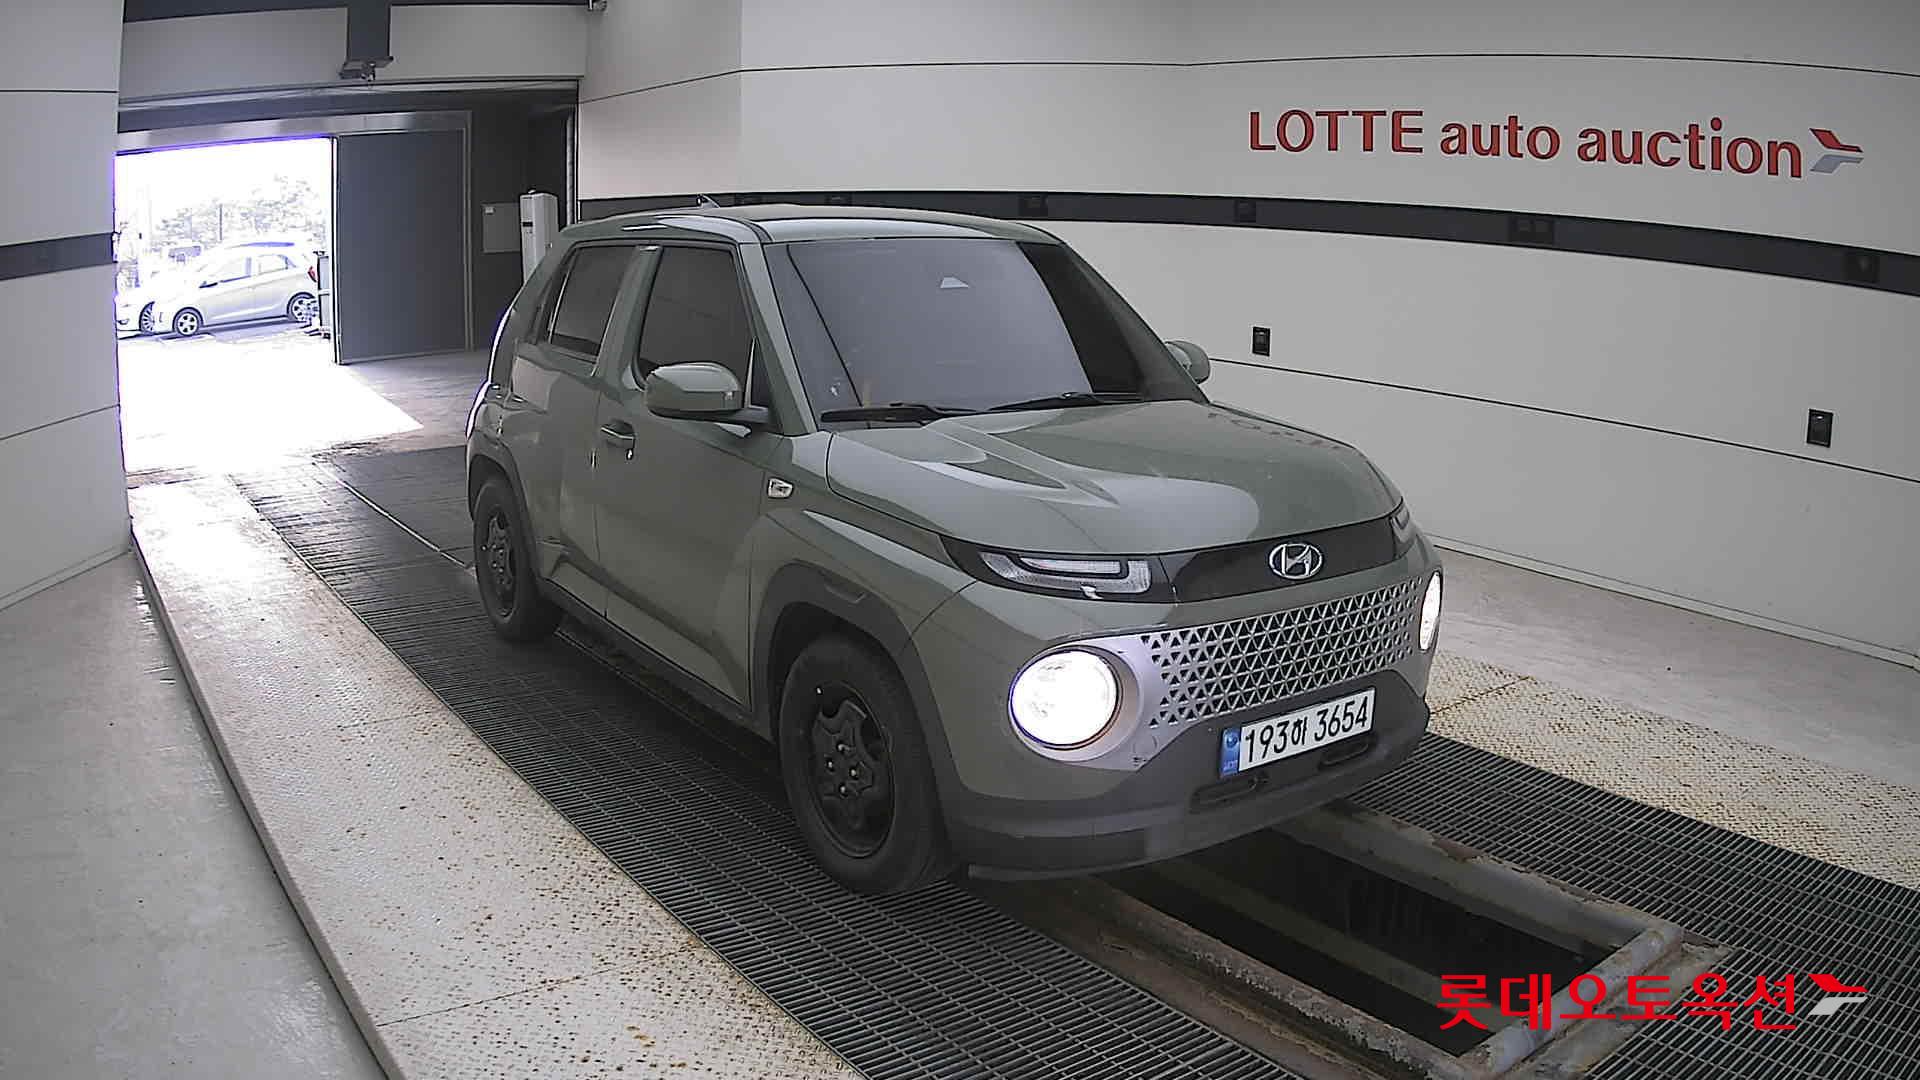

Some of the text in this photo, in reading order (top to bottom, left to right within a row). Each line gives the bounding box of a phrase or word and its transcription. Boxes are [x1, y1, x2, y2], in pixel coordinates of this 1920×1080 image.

[1249, 110, 1802, 178] LOTTE auto auction
[1245, 696, 1369, 763] 193하 3654
